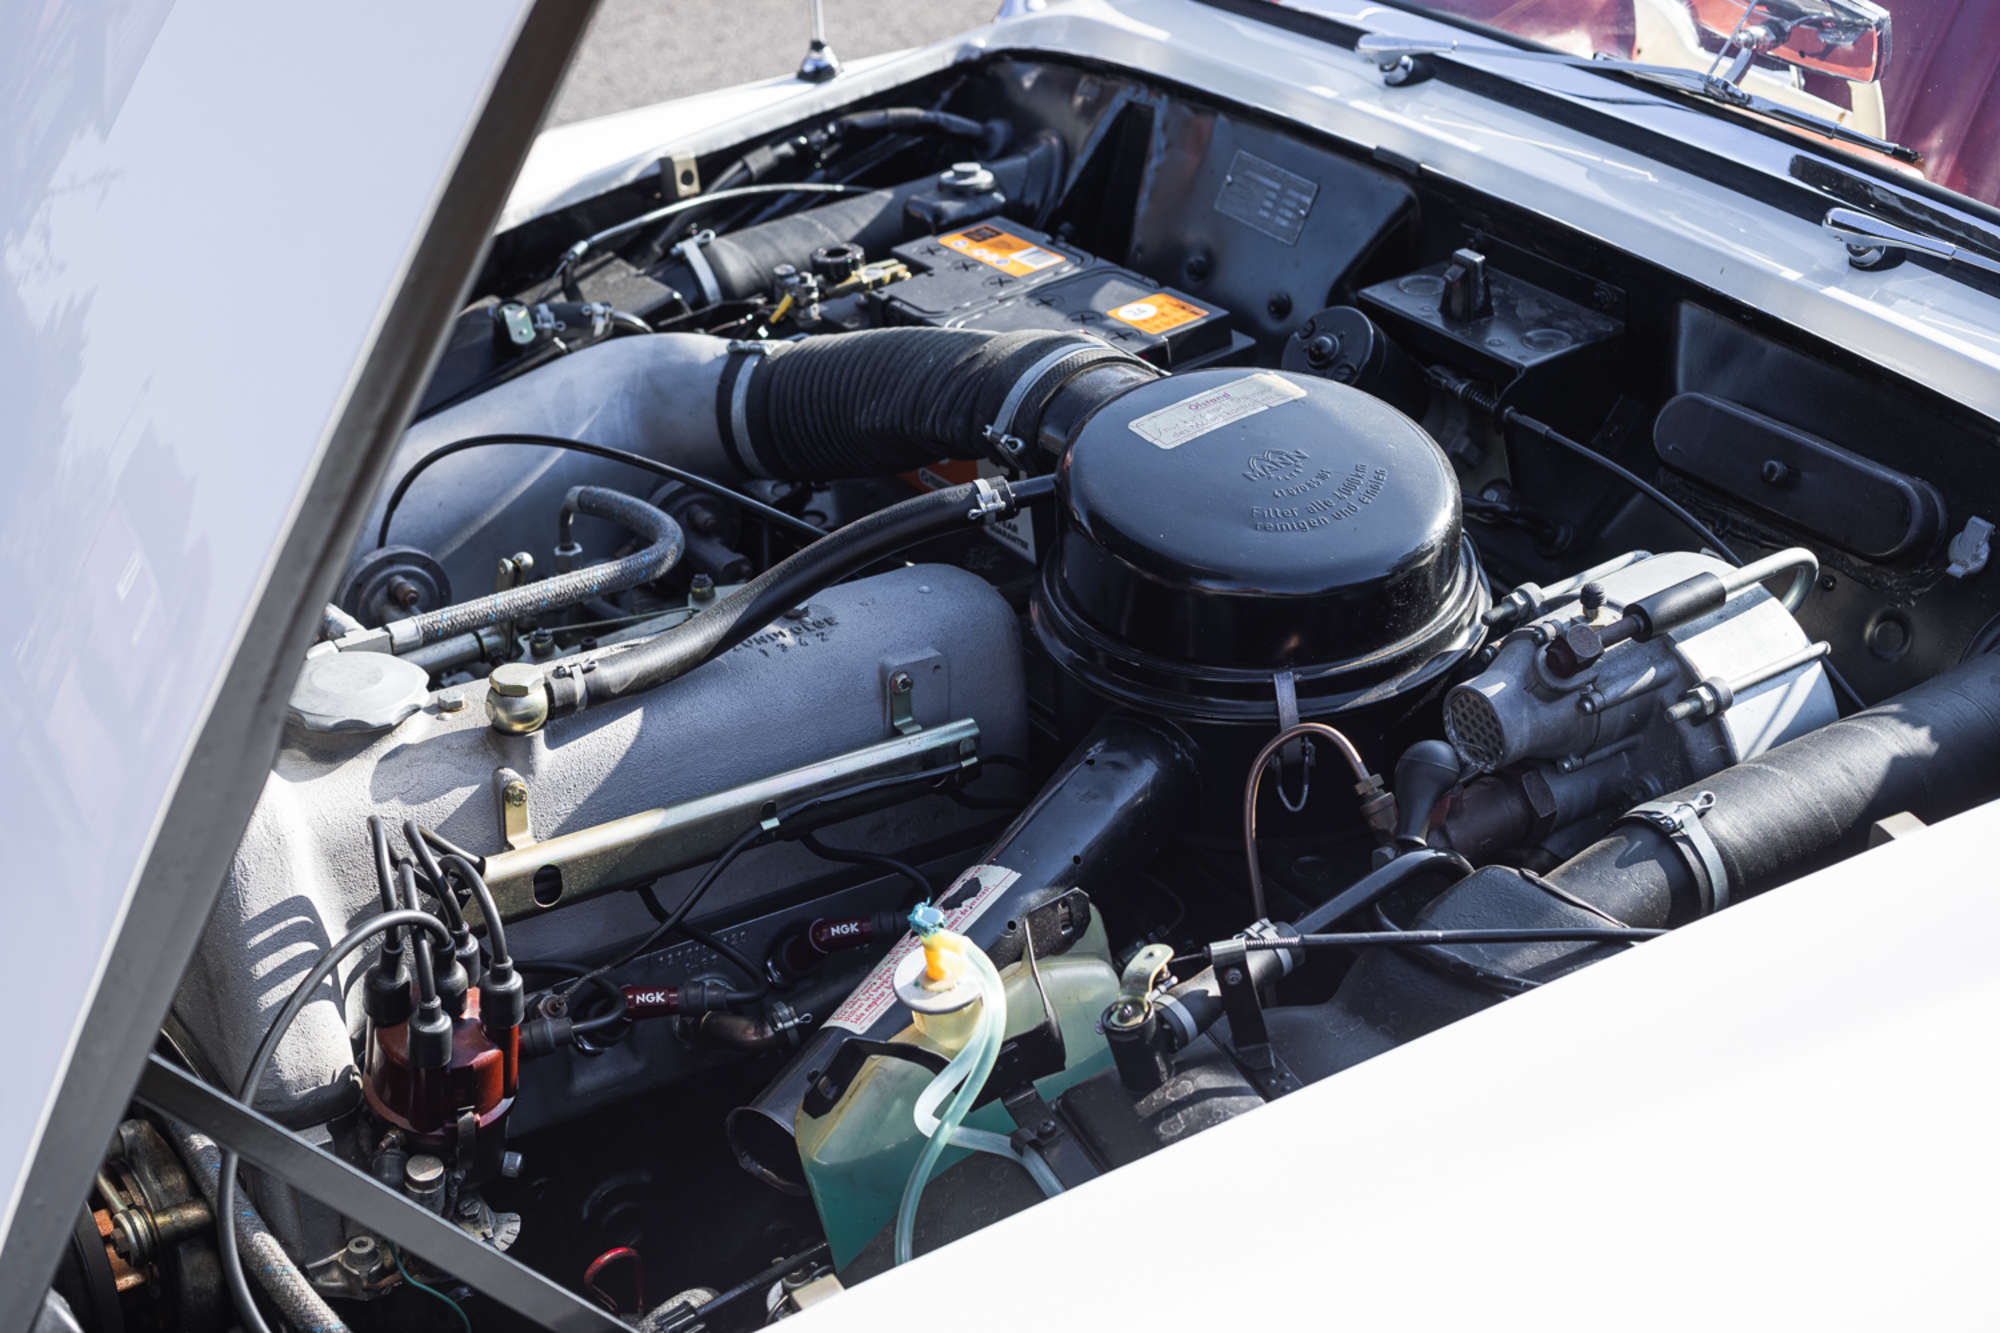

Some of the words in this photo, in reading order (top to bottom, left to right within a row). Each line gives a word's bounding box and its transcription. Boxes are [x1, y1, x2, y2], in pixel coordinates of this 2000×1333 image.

[1252, 505, 1299, 519] Filter
[831, 922, 859, 936] NGK
[635, 991, 665, 1004] NGK
